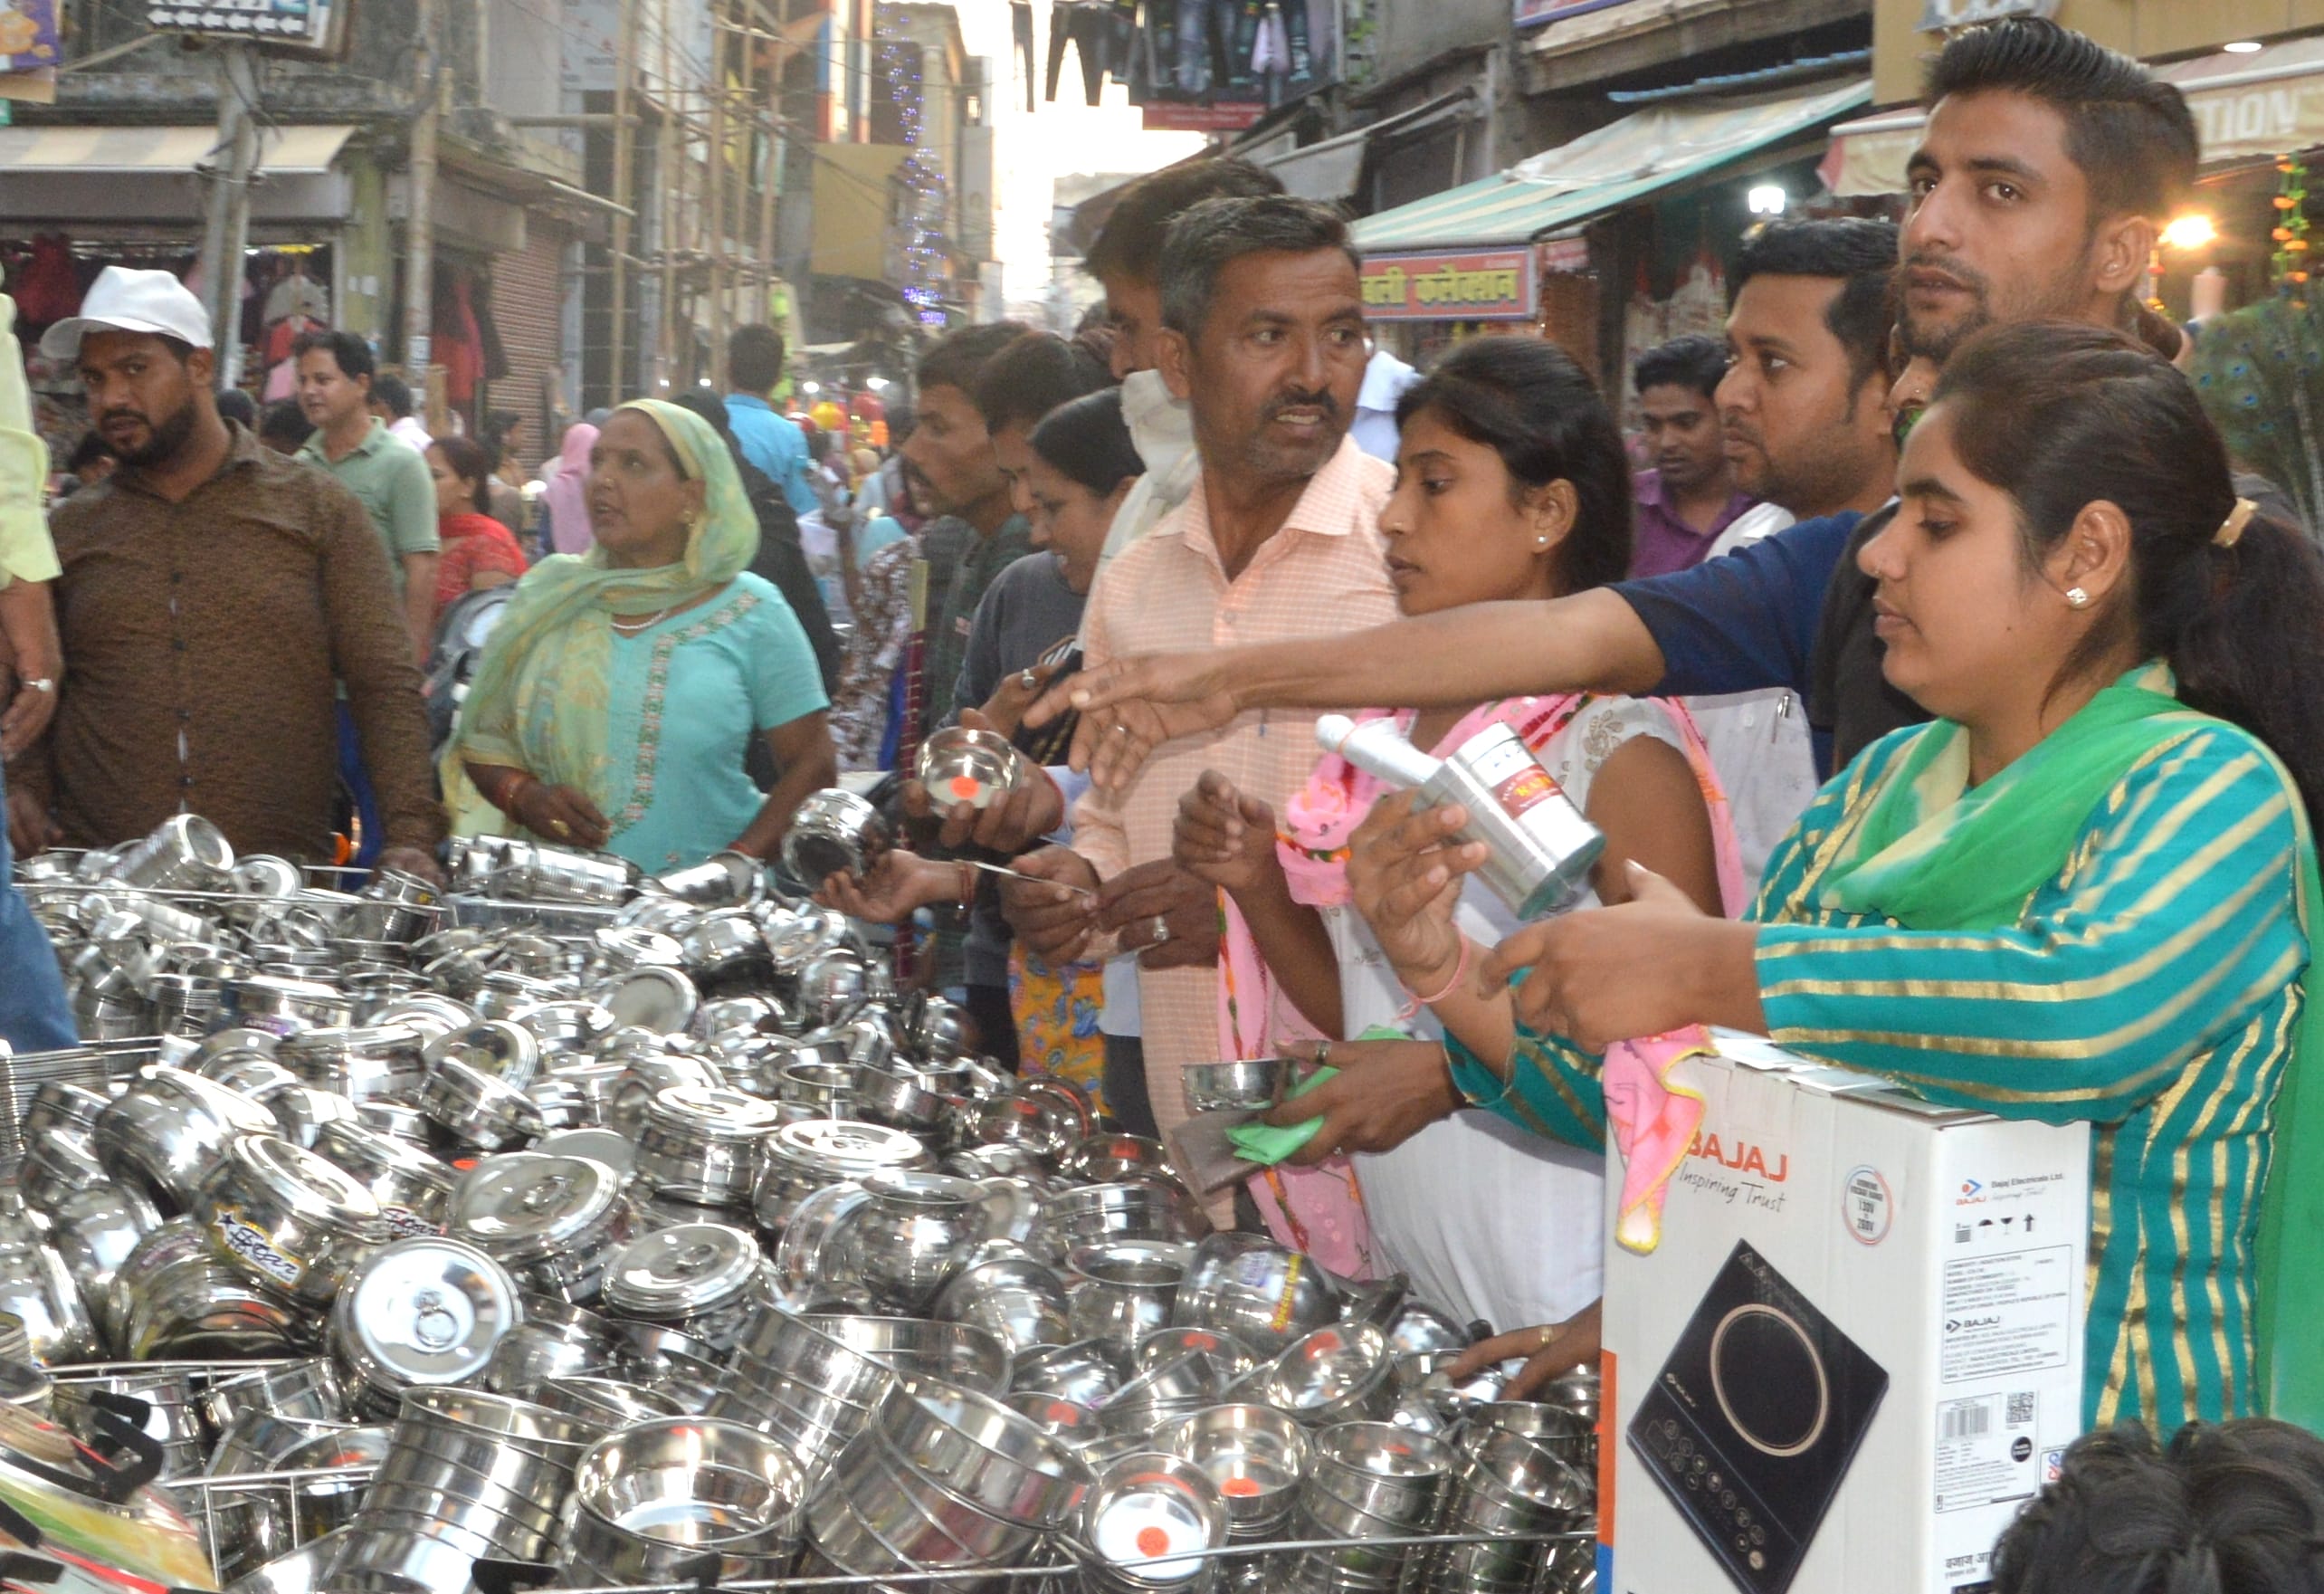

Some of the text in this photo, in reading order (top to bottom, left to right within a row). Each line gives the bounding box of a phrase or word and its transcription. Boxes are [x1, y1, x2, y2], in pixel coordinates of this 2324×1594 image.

[2187, 90, 2299, 144] TION
[1686, 1131, 1787, 1182] BAJAJ
[1679, 1161, 1786, 1213] Inspiring Trust
[1964, 1316, 2000, 1328] BAJAJ
